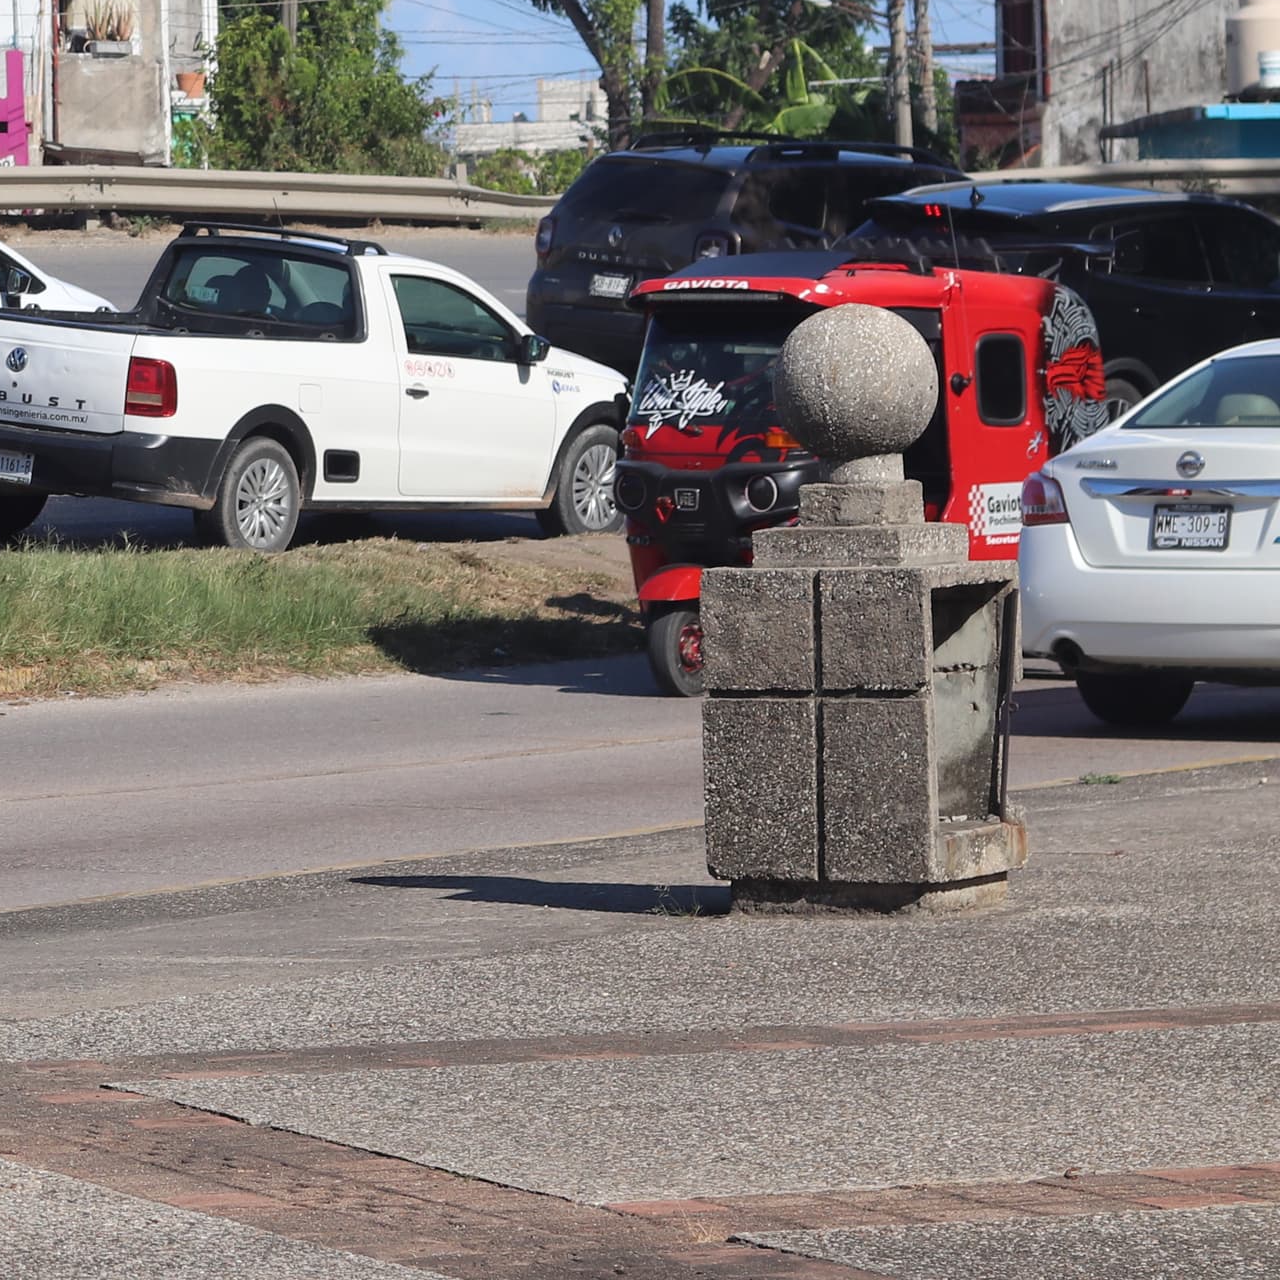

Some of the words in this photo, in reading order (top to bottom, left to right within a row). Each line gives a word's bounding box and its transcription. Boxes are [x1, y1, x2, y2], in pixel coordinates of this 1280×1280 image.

[663, 279, 749, 290] GAVIOTA
[1155, 514, 1226, 534] WME-309-B
[1180, 538, 1224, 548] NISSAN
